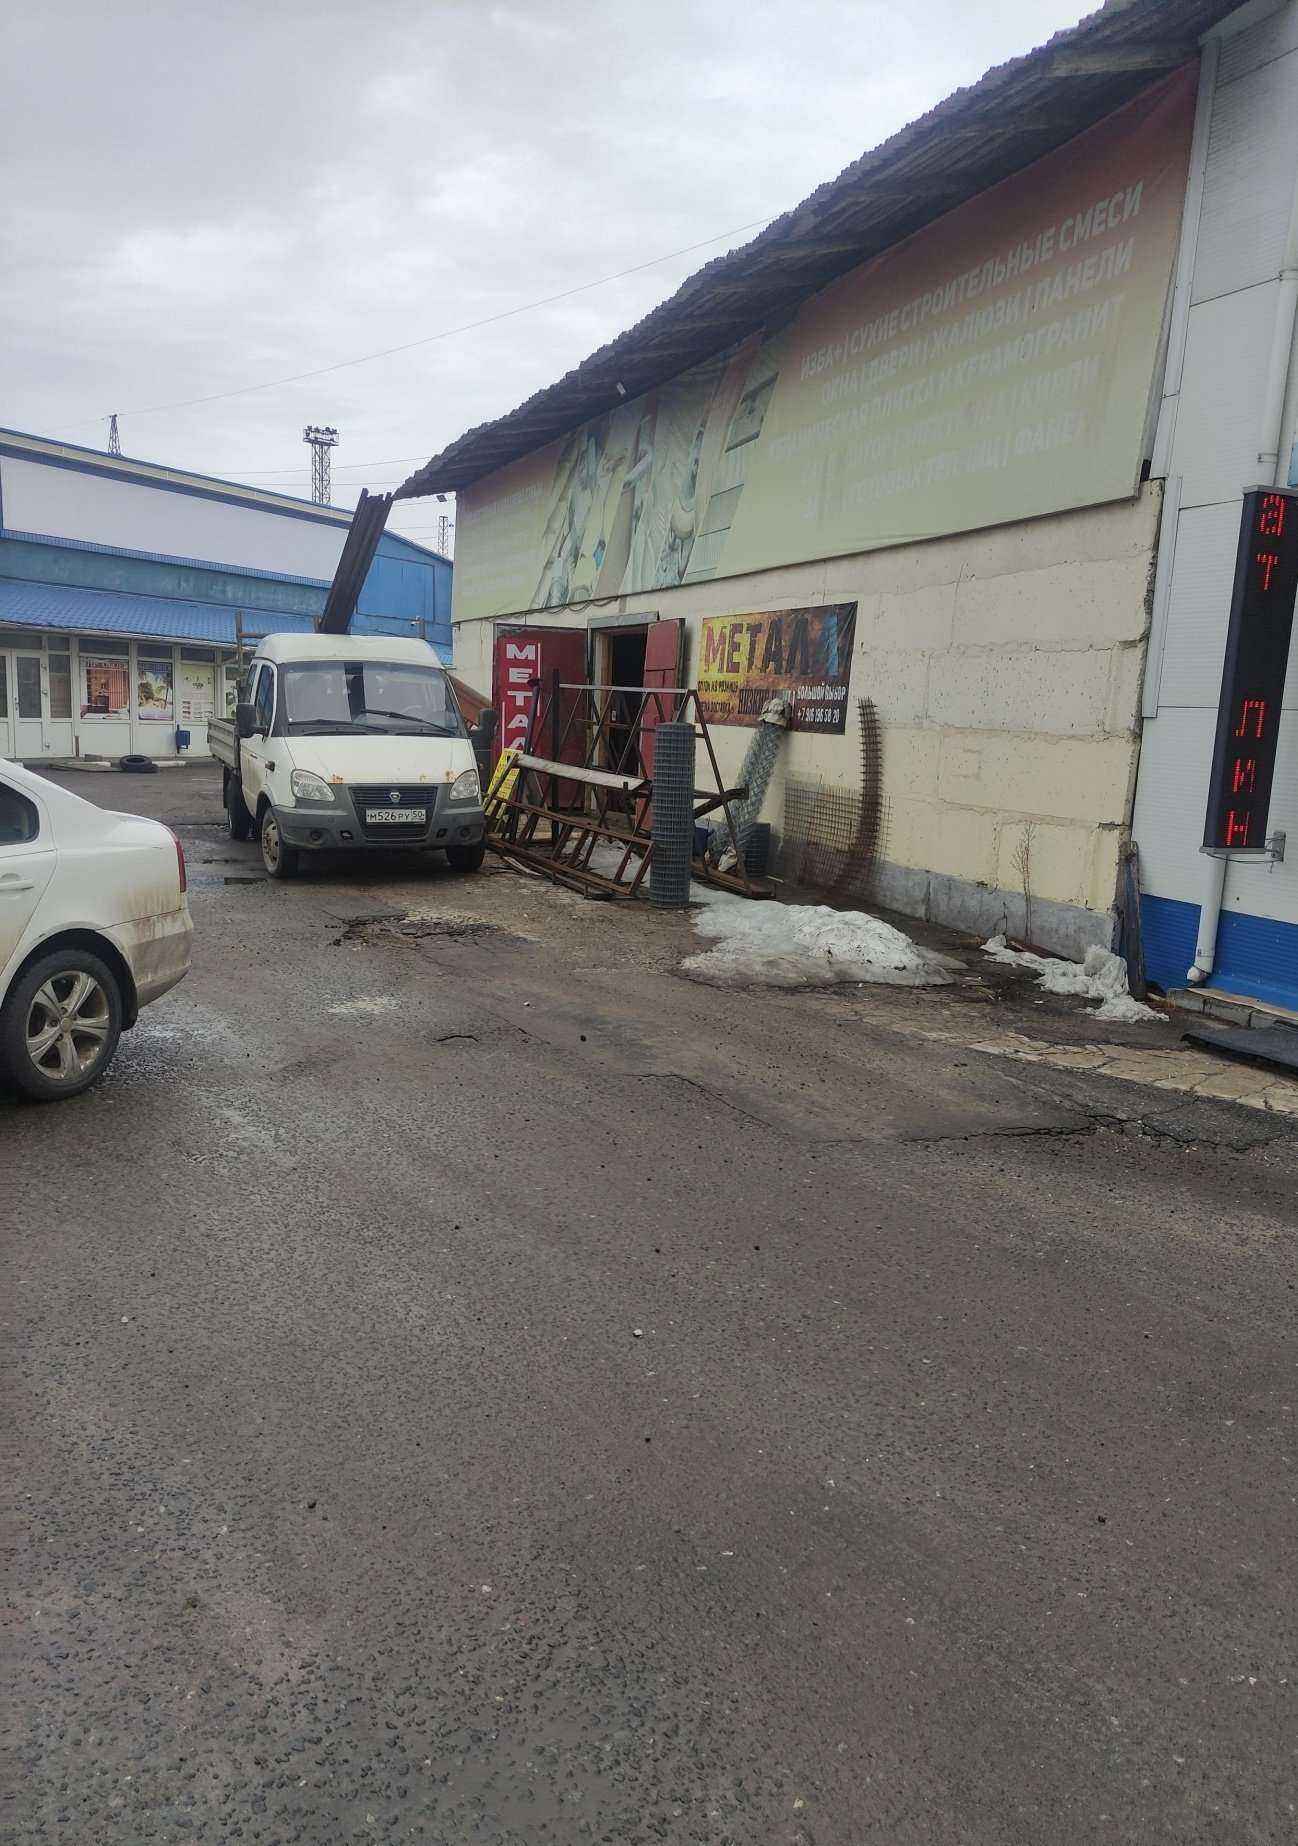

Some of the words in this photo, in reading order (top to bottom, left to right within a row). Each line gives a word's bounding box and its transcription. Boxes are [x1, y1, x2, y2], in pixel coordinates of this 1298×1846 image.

[850, 307, 898, 352] СУХИЕ
[902, 229, 1056, 326] СТРОИТЕЛЬНЫЕ
[1060, 181, 1145, 252] СМЕСИ
[930, 298, 1020, 360] ЖАЛЮЗИ
[1031, 238, 1136, 311] ПАНЕЛИ
[797, 682, 825, 701] БОЛЬШОЙ
[824, 684, 847, 701] ВЫБОР
